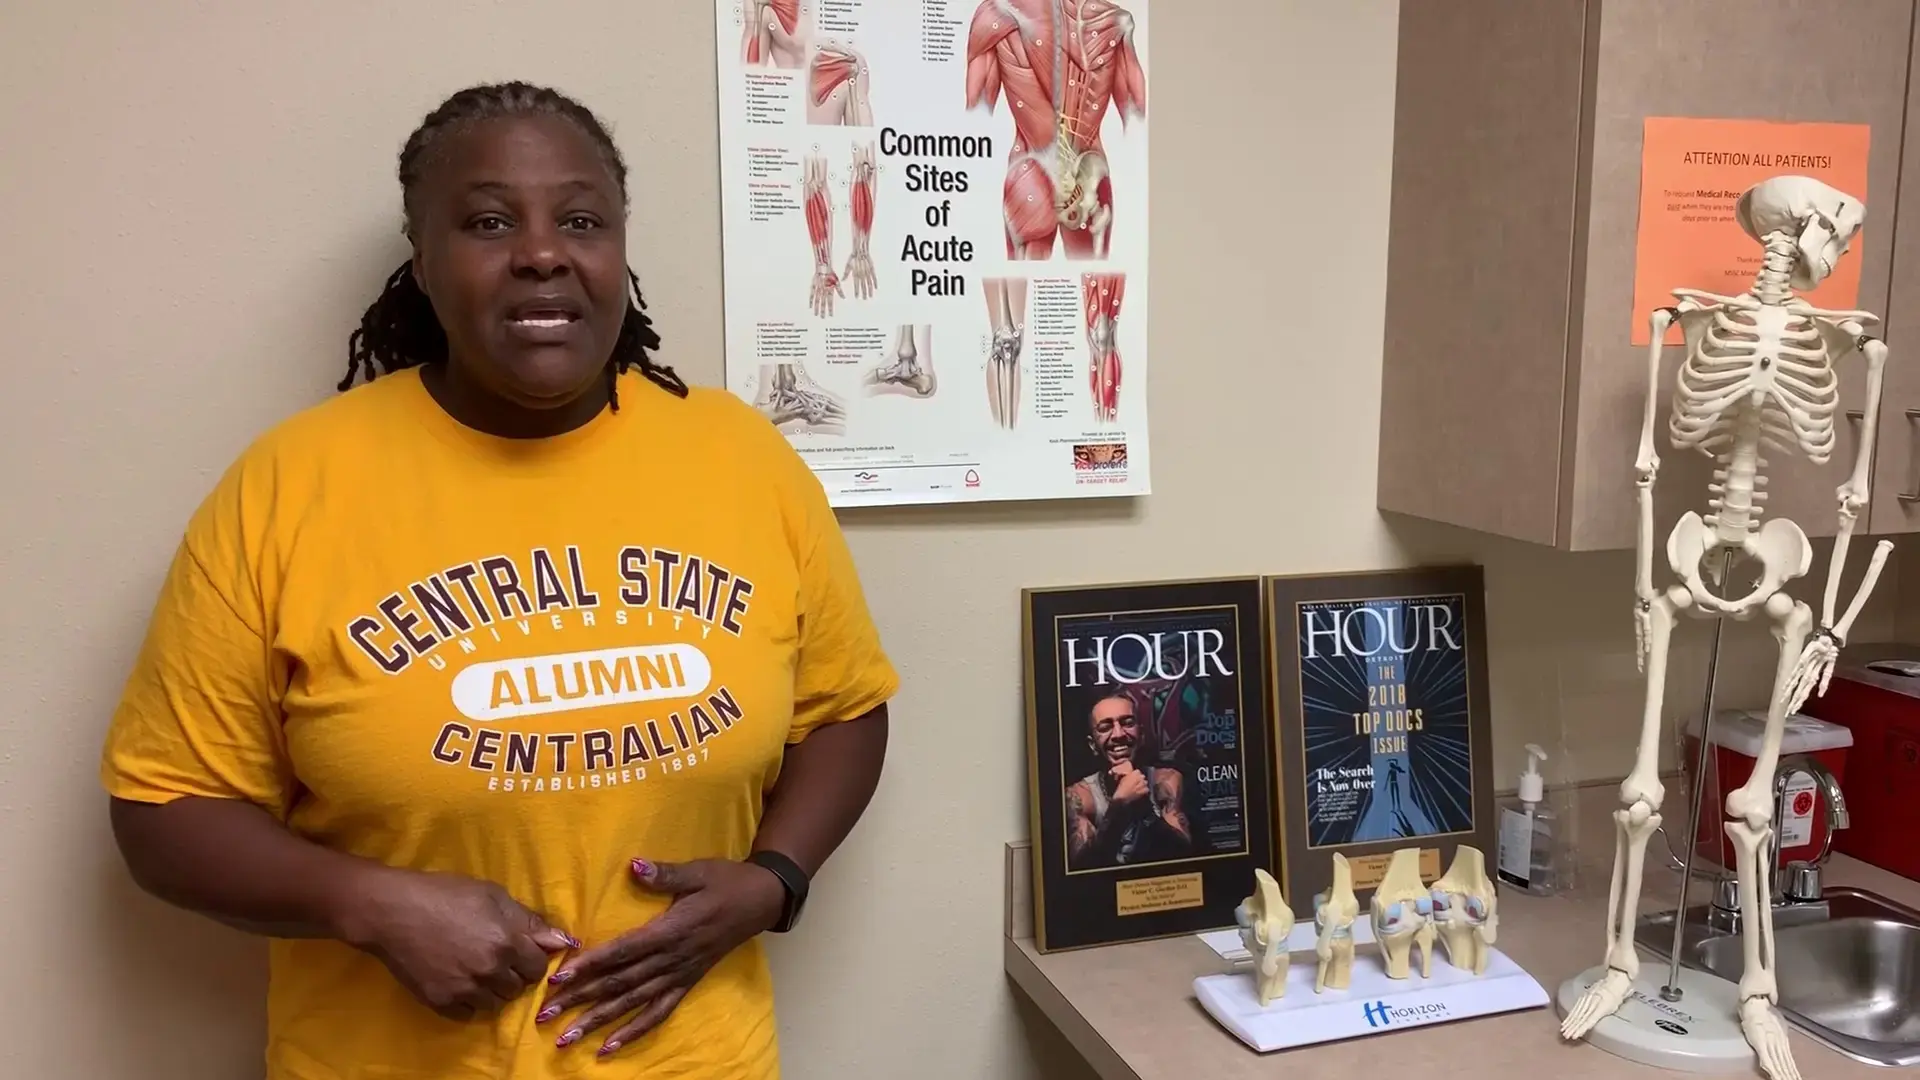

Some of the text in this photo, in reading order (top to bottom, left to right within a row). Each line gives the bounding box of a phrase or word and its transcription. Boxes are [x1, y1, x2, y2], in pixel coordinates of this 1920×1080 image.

[880, 126, 993, 159] Common
[1683, 151, 1831, 169] ATTENTION ALL PATIENTS!
[905, 165, 969, 193] Sites
[1696, 190, 1723, 198] Medical
[925, 200, 951, 228] of
[901, 234, 975, 263] Acute
[911, 269, 966, 297] Pain
[347, 545, 755, 676] CENTRAL STATE
[427, 609, 712, 672] UNIVERSITY
[1302, 604, 1462, 659] HOUR
[1063, 628, 1235, 688] HOUR
[1365, 655, 1404, 663] DETROIT
[488, 653, 687, 710] ALUMNI
[1378, 666, 1395, 680] THE
[1368, 684, 1406, 706] 2018
[431, 685, 746, 776] CENTRALIAN
[1353, 709, 1424, 735] TOP DOCS
[1373, 735, 1408, 754] ISSUE
[487, 749, 711, 793] ESTABLISHED 1887
[1197, 764, 1238, 782] CLEAN
[1316, 764, 1375, 780] The Search
[1200, 780, 1239, 797] SLATE
[1317, 778, 1376, 793] Is Now Over
[1390, 1002, 1447, 1018] HORIZON
